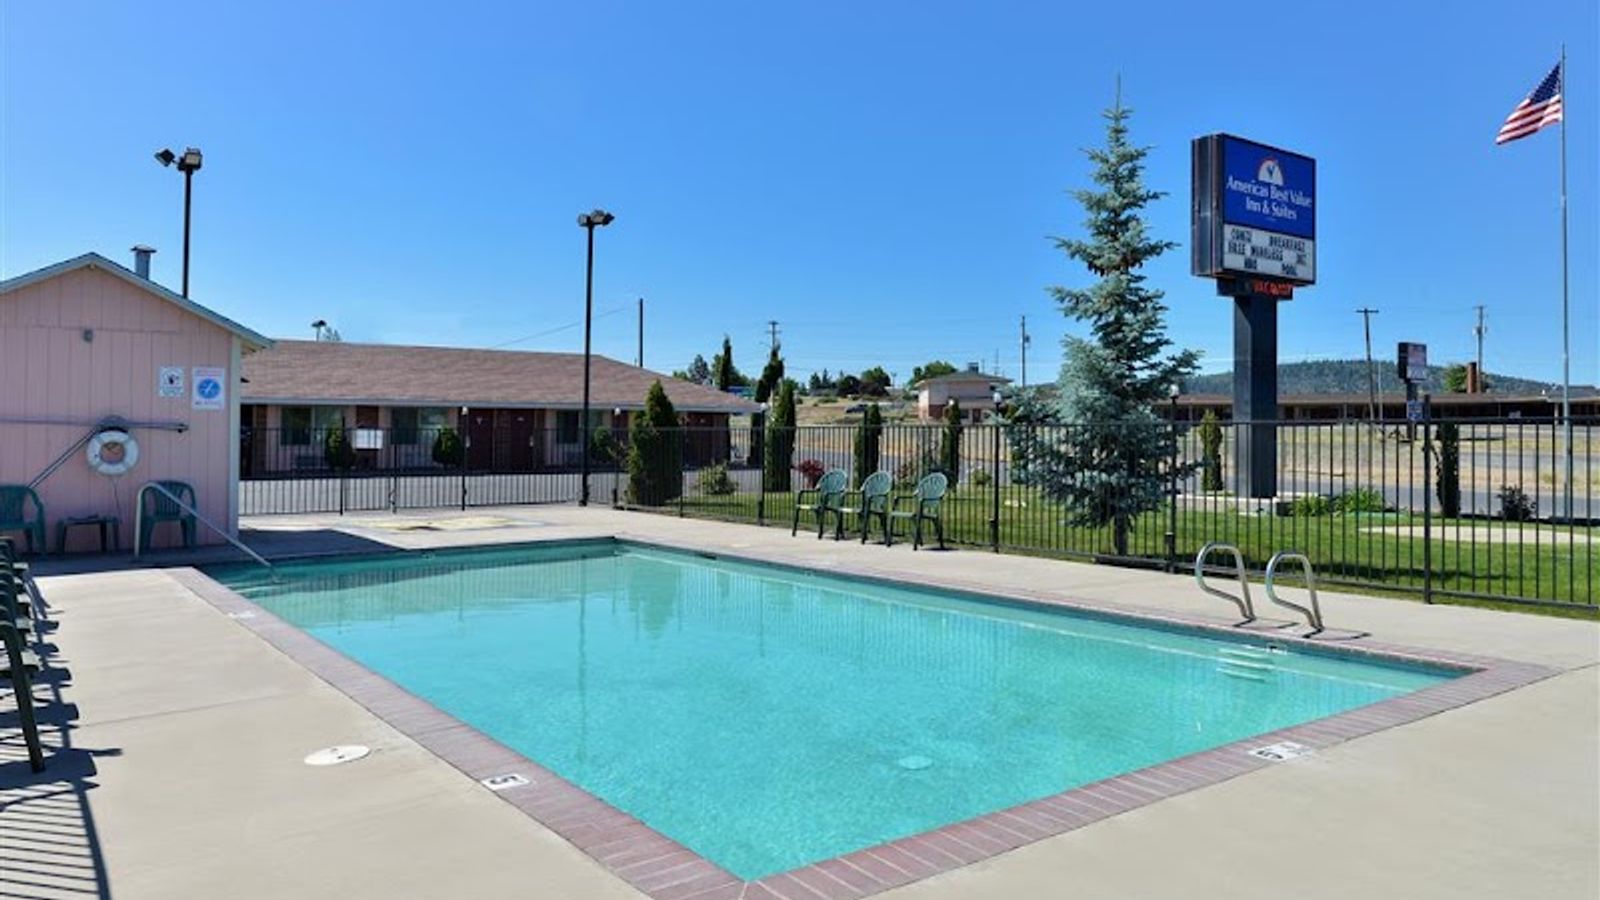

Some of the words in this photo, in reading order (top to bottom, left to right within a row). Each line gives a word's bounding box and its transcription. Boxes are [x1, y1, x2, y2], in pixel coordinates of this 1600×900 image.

[1226, 175, 1269, 198] Americas
[1270, 185, 1289, 203] Best
[1289, 190, 1312, 208] Value
[1246, 196, 1261, 213] Inn
[1262, 200, 1270, 215] &
[1271, 202, 1297, 220] Suites
[1228, 241, 1246, 255] FREE
[1269, 236, 1305, 252] BREAKFAST
[1281, 263, 1297, 276] POOL
